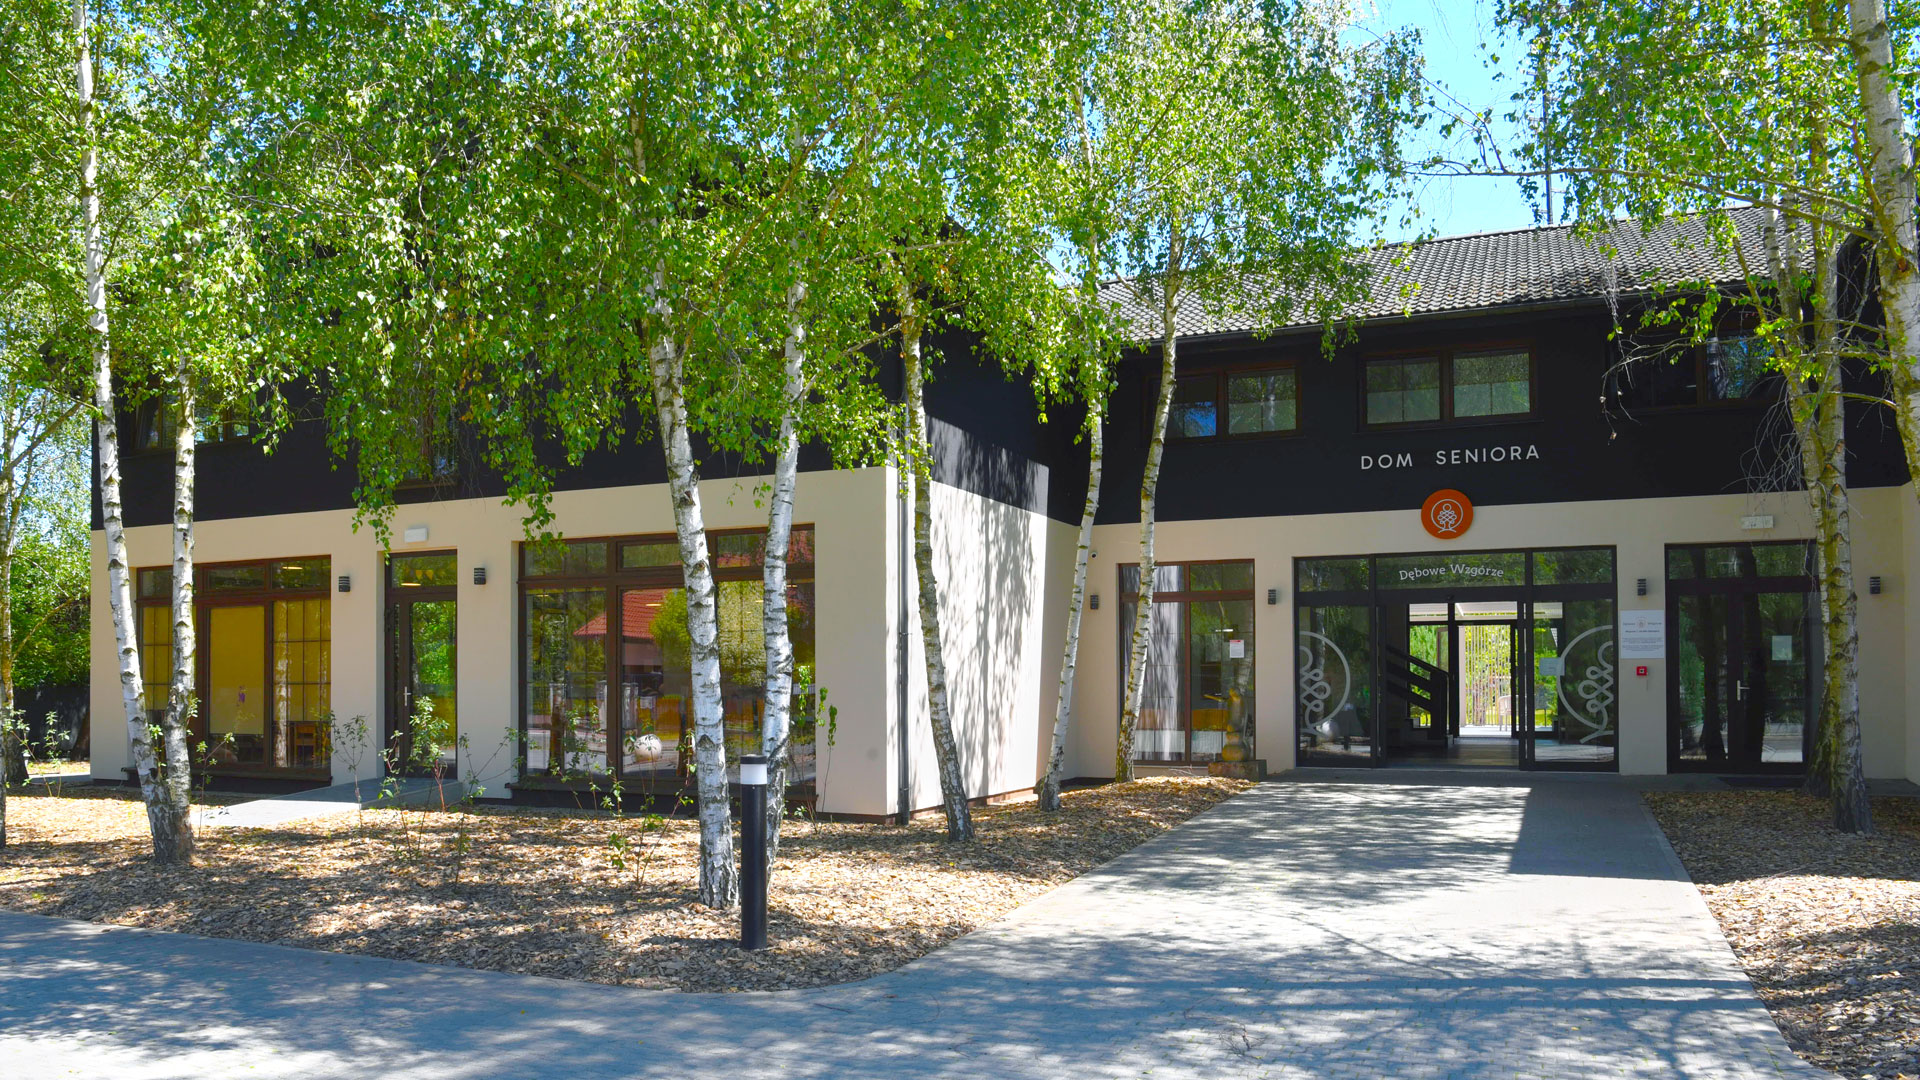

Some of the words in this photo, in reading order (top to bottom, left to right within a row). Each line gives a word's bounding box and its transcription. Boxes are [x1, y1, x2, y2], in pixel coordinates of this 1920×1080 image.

[1361, 453, 1413, 470] DOM
[1436, 445, 1540, 465] SENIORA
[1399, 567, 1446, 581] Dębowe
[1450, 563, 1504, 577] Wzgórze
